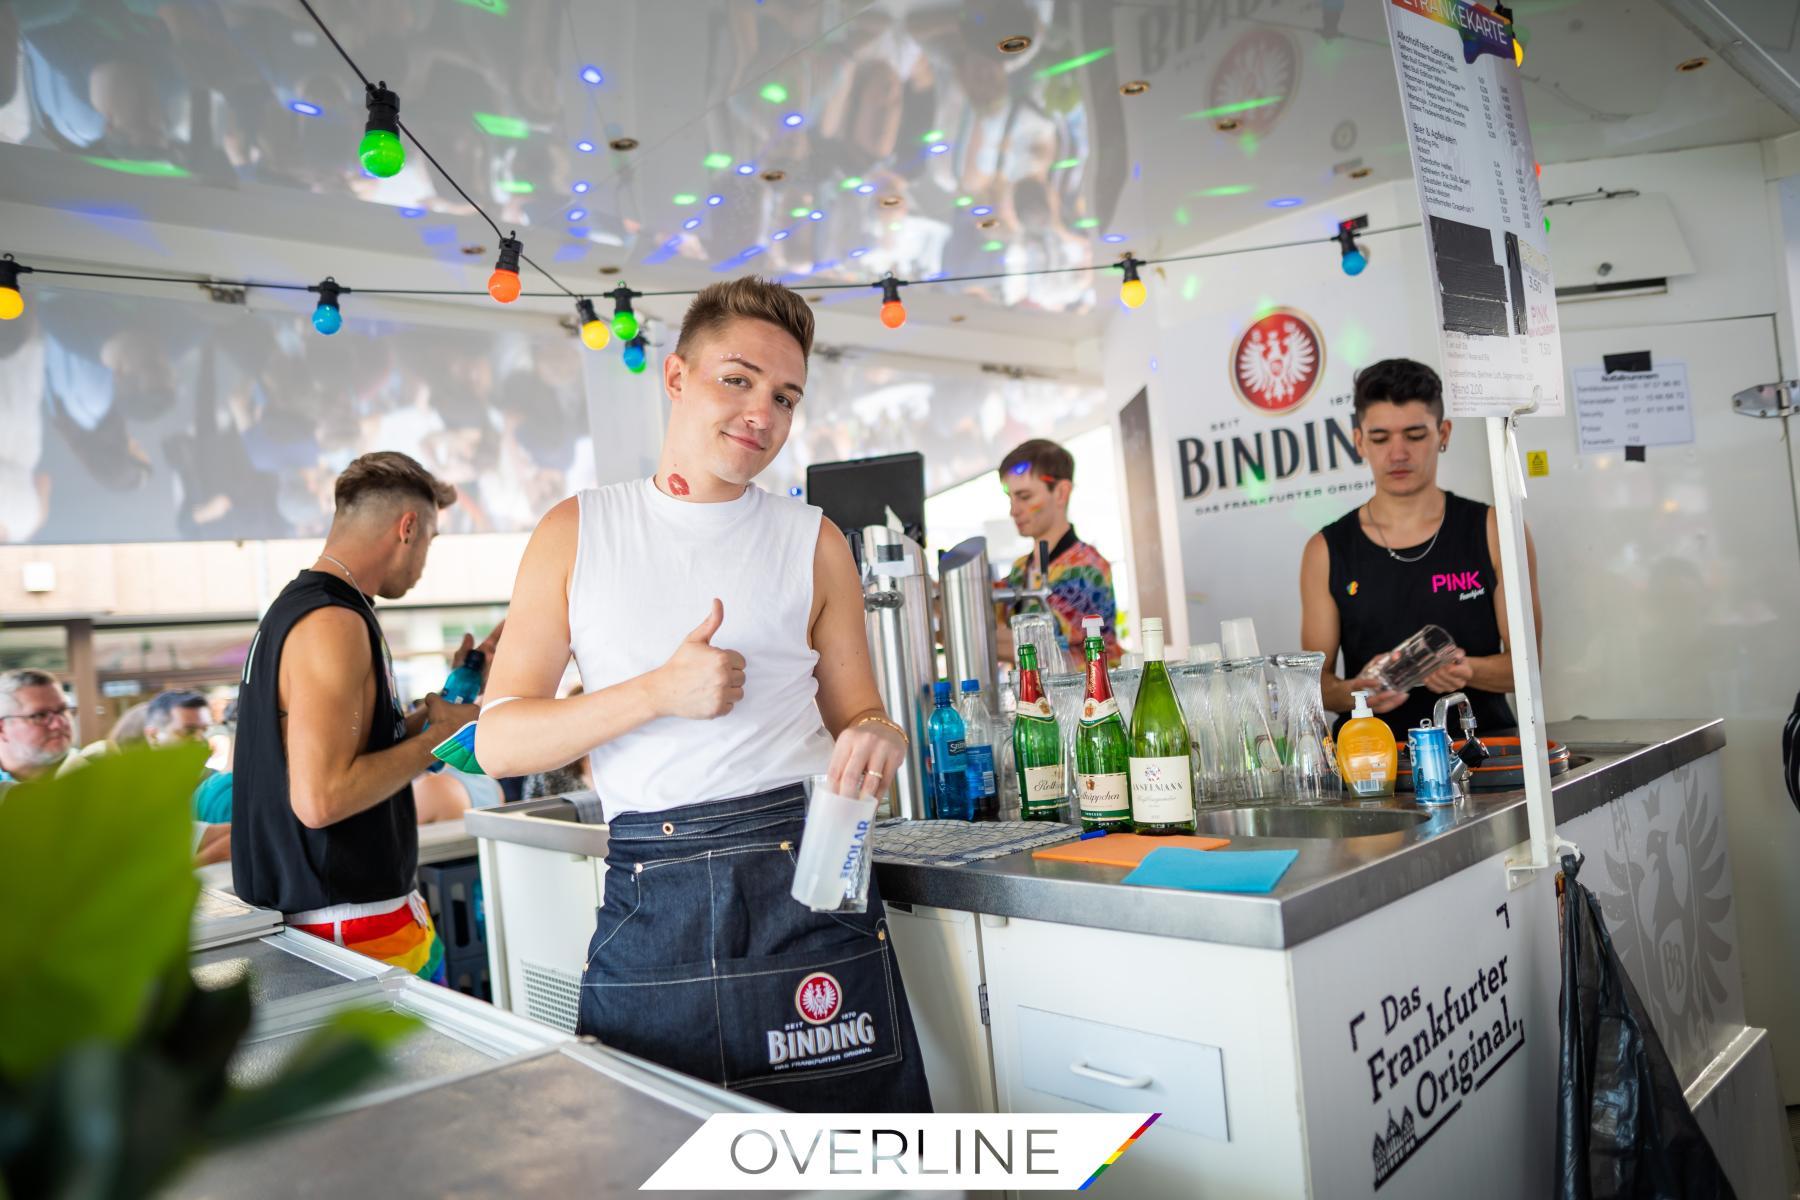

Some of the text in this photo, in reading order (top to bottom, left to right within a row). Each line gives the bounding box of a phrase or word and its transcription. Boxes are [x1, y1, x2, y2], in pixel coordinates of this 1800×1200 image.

[1210, 394, 1354, 432] SEIT 187
[1177, 413, 1364, 501] BINDIN
[1194, 480, 1374, 516] DAS FRANKFURTER ORIGI
[1431, 570, 1482, 593] PINK
[784, 1011, 857, 1031] SEIT 1870
[1367, 955, 1509, 1104] Frankfurter
[1380, 985, 1422, 1036] Das
[767, 1011, 876, 1065] BINDING
[1416, 995, 1518, 1120] Original.
[791, 1054, 841, 1068] FRANKFURTER
